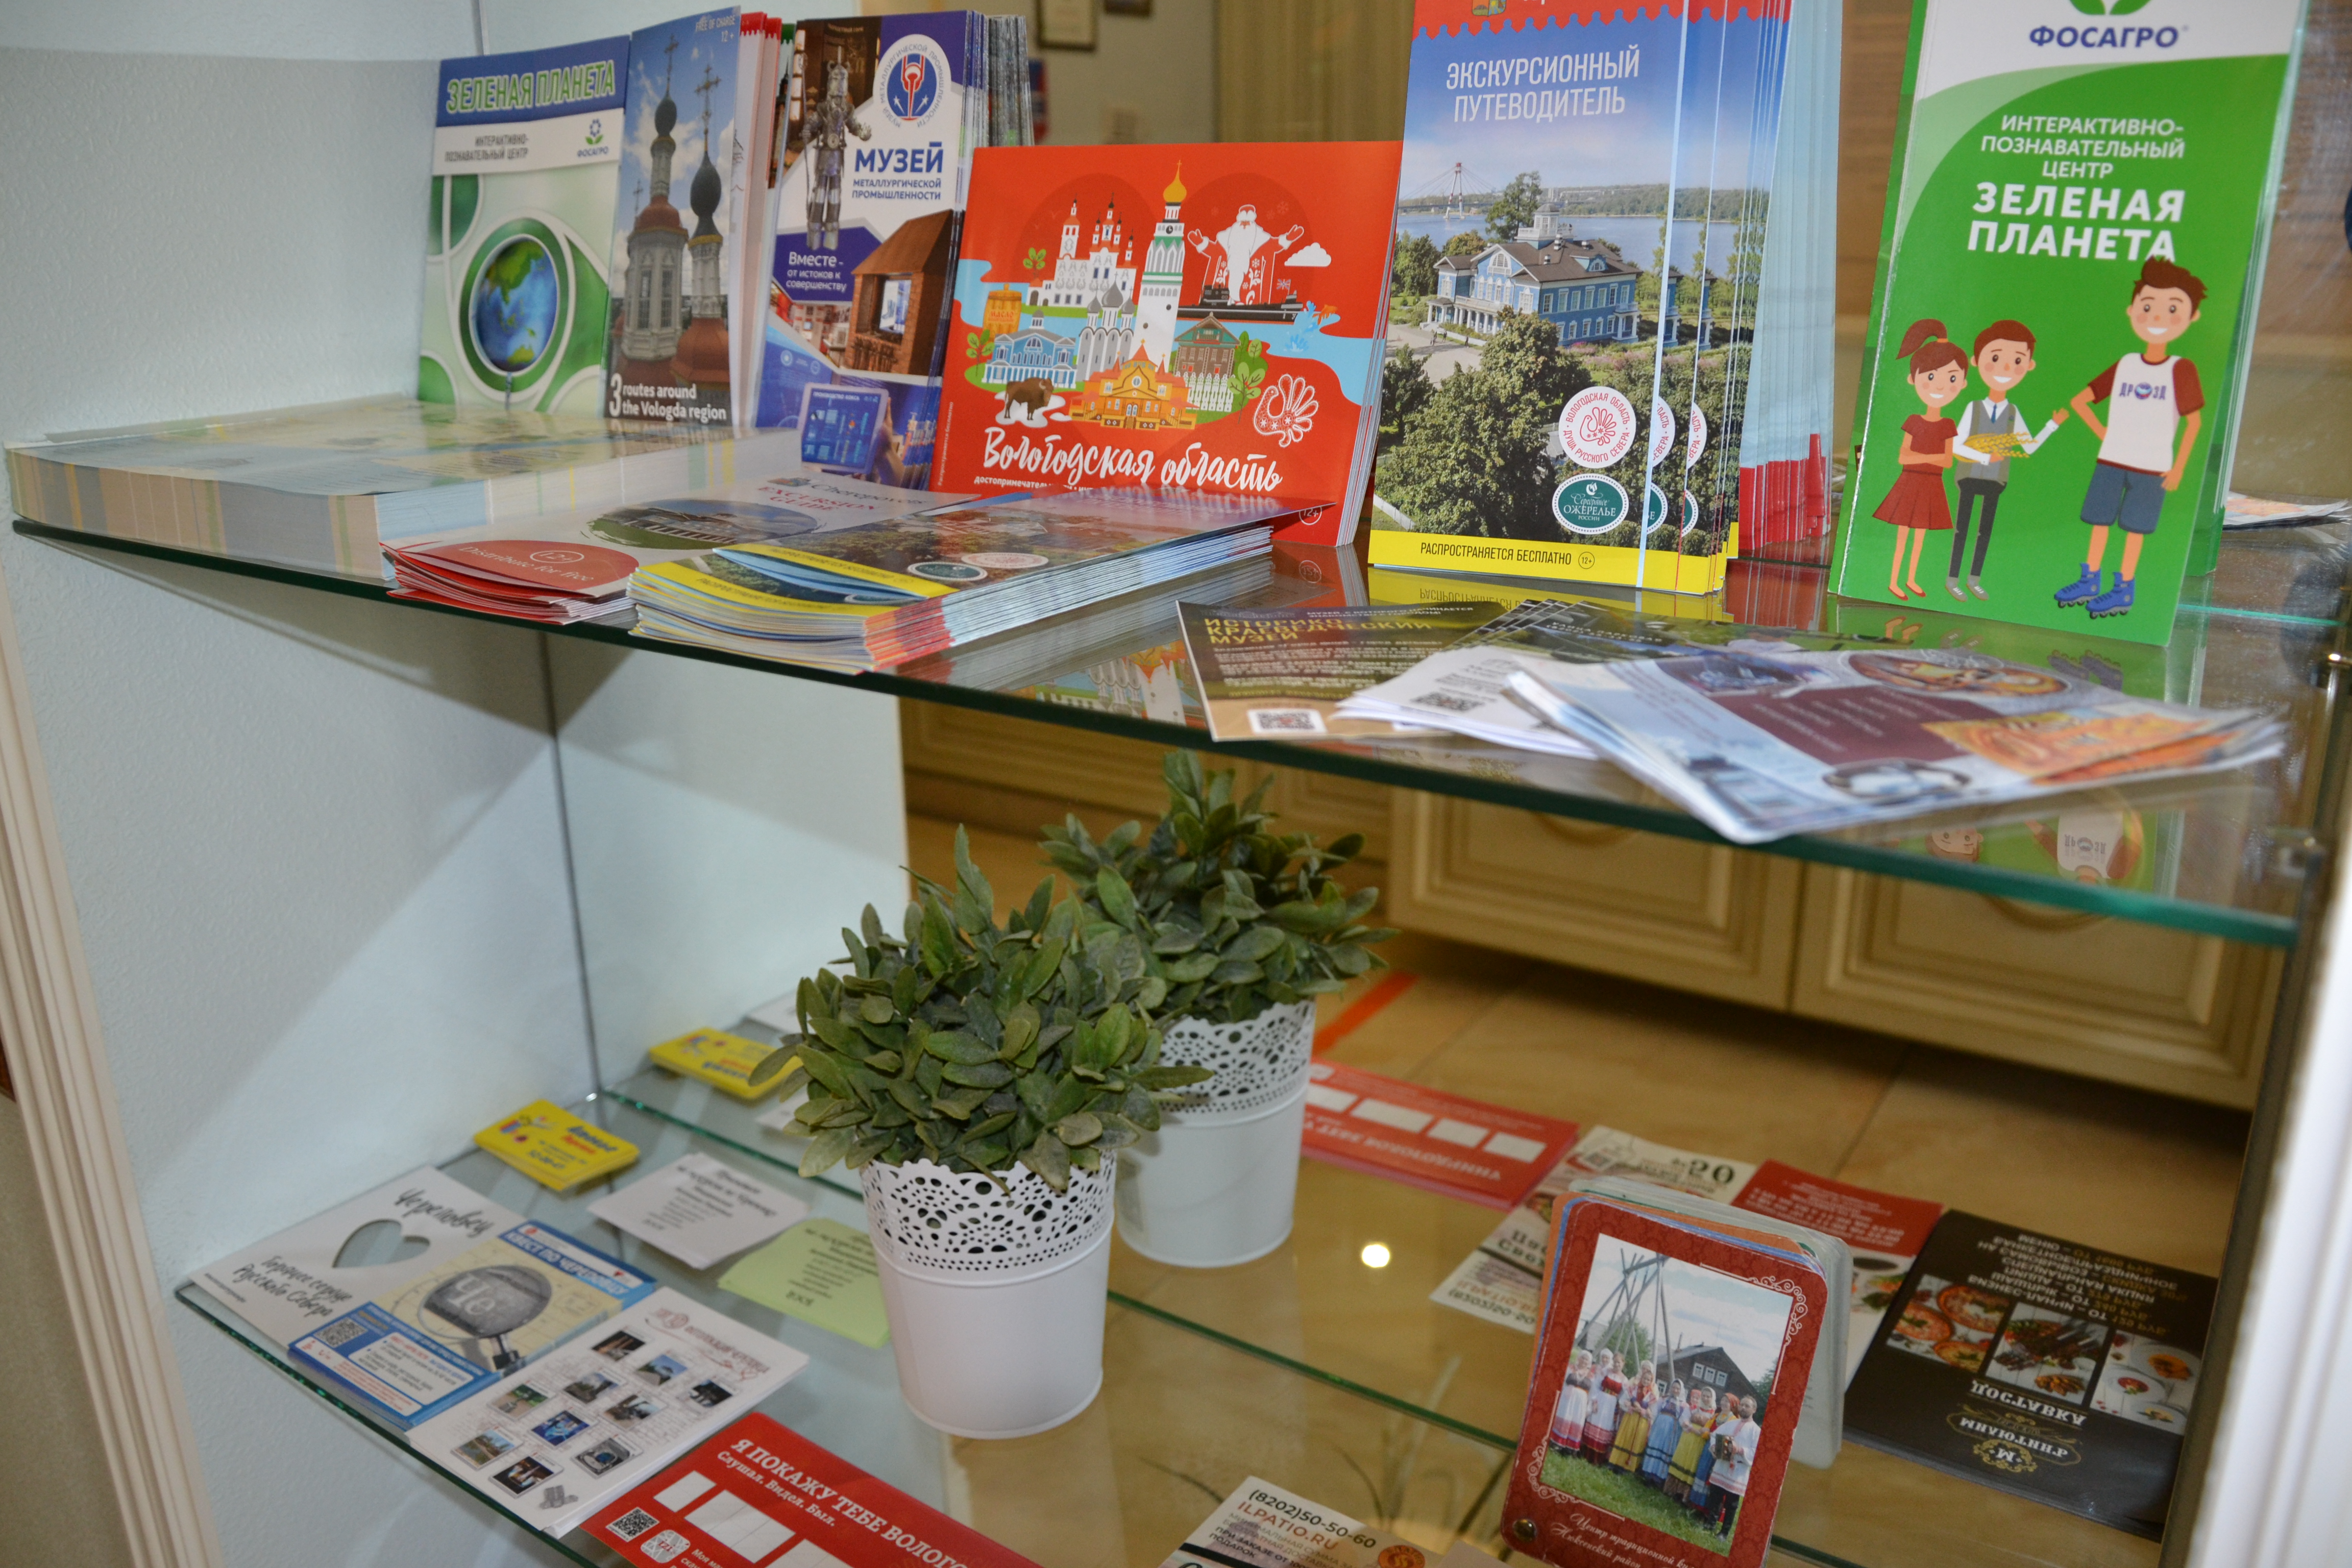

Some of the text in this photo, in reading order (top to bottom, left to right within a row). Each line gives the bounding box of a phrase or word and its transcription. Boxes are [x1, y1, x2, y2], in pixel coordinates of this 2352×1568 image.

[2029, 26, 2178, 47] ФОСАГРО
[1446, 44, 1640, 90] ЭКСКУРСИОННЫЙ
[447, 60, 615, 114] ЗЕЛЕНАЯ ПЛАНЕТА
[880, 43, 945, 128] МУЗЕЙ МЕТАЛЛУРГИЧЕСКОЙ ПРОМЫШЛЕННОСТИ
[1454, 86, 1626, 124] ПУТЕВОДИТЕЛЬ
[2001, 115, 2185, 136] ИНТЕРАКТИВНО-
[475, 134, 528, 148] ИНТЕРАКТИВНО-
[577, 146, 609, 157] ФОСАГРО
[1981, 135, 2185, 158] ПОЗНАВАТЕЛЬНЫЙ
[445, 148, 528, 162] ПОЗНАВАТЕЛЬНЫЙ ЦЕНТР
[854, 141, 943, 173] МУЗЕЙ
[853, 177, 941, 188] МЕТАЛЛУРГИЧЕСКОЙ
[2042, 161, 2114, 180] ЦЕНТР
[852, 189, 941, 200] ПРОМЫШЛЕННОСТИ
[1972, 181, 2186, 223] ЗЕЛЕНАЯ
[1967, 219, 2176, 262] ПЛАНЕТА
[789, 252, 837, 267] Вместе
[786, 279, 847, 292] совершенству
[787, 270, 841, 280] от истоков к
[609, 373, 622, 416] 3
[623, 383, 697, 399] routes around
[622, 400, 727, 424] the Vologda region
[945, 401, 954, 432] бесплатно
[1566, 393, 1630, 425] ВОЛОГОДСКАЯ ОБЛАСТЬ
[983, 426, 1283, 492] Вологодская область
[1563, 430, 1630, 463] ДУША РУССКОГО СЕВЕРА
[759, 486, 874, 510] EXCURSION
[770, 496, 834, 511] GUIDE
[1571, 493, 1608, 507] Серебряное
[1563, 505, 1616, 517] ОЖЕРЕЛЬЕ
[459, 547, 594, 581] Distribute for free
[1420, 542, 1572, 565] РАСПРОСТРАНЯЕТСЯ БЕСПЛАТНО
[1581, 556, 1593, 565] 12+
[1204, 618, 1342, 627] ИСТОРИКО
[717, 1451, 836, 1527] Слушал. Видел. Был.
[731, 1438, 752, 1454] Я
[749, 1444, 838, 1501] ПОКАЖУ
[836, 1495, 888, 1533] ТЕБЕ
[1238, 1501, 1339, 1551] ILPATIO.RU
[1248, 1489, 1377, 1549] (8202)50-50-60
[1228, 1513, 1304, 1551] МИНИМАЛЬНАЯ
[1551, 1523, 1613, 1563] Нюксенский
[1569, 1512, 1609, 1539] Центр
[1610, 1531, 1675, 1566] традиционной
[691, 1548, 710, 1563] Моя
[1209, 1532, 1257, 1559] ПОДАРОК
[1215, 1526, 1234, 1538] ПРИ
[1234, 1534, 1276, 1557] ЗАКАЗЕ
[1275, 1552, 1288, 1564] ОТ
